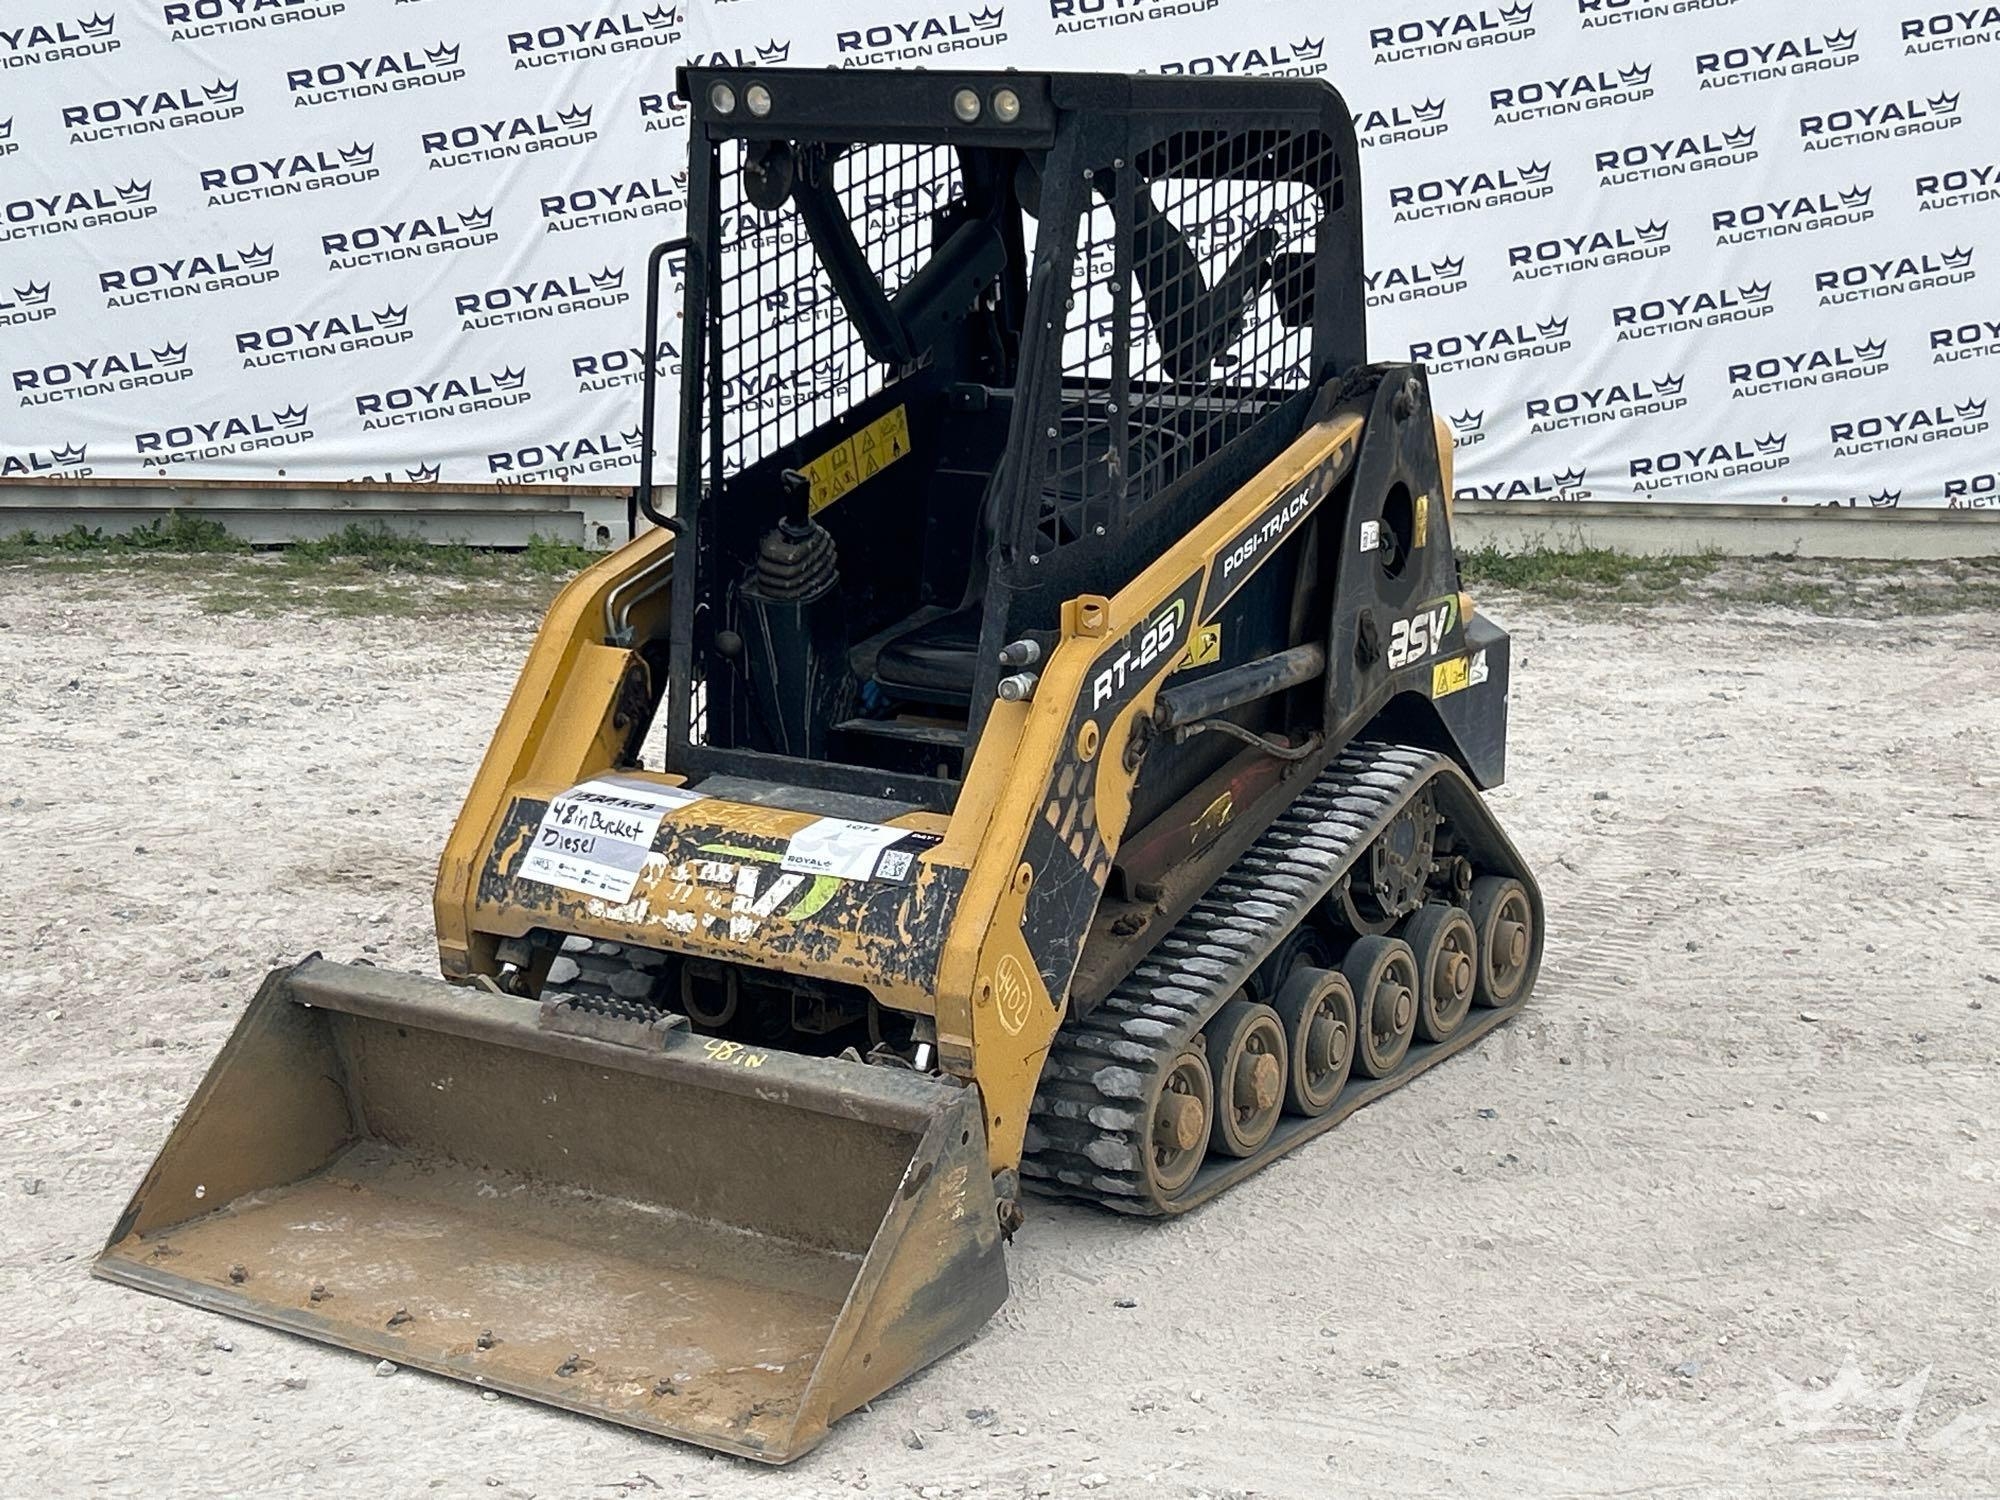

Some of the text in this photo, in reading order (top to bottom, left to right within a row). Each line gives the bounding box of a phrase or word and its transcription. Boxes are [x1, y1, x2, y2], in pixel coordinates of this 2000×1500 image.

[172, 3, 345, 42] AUCTION GROUP
[508, 14, 644, 54] ROYAL
[837, 15, 970, 52] ROYAL
[1055, 11, 1144, 35] AUCTION
[1149, 0, 1218, 19] GROUP
[1370, 11, 1499, 49] ROYAL
[1582, 5, 1668, 29] AUCTION
[1901, 7, 2000, 40] ROYA
[0, 22, 80, 50] YAL
[45, 40, 121, 61] GROUP
[515, 32, 681, 70] AUCTION GROUP
[843, 33, 1007, 69] AUCTION GROUP
[1375, 28, 1535, 65] AUCTION GROUP
[1904, 32, 1990, 56] AUCTION
[287, 52, 426, 91] ROYAL
[1696, 37, 1823, 74] ROYAL
[1700, 54, 1859, 90] AUCTION GROUP
[295, 69, 465, 107] AUCTION GROUP
[1490, 72, 1618, 109] ROYAL
[62, 89, 204, 128] ROYAL
[70, 106, 244, 144] AUCTION GROUP
[1494, 89, 1653, 125] AUCTION GROUP
[1800, 100, 1926, 137] ROYAL
[422, 115, 558, 153] ROYAL
[429, 131, 597, 170] AUCTION GROUP
[1380, 124, 1448, 144] GROUP
[1804, 117, 1961, 152] AUCTION GROUP
[200, 152, 340, 191] ROYAL
[1595, 135, 1722, 172] ROYAL
[1600, 151, 1758, 187] AUCTION GROUP
[208, 169, 379, 207] AUCTION GROUP
[540, 179, 673, 217] ROYAL
[1390, 170, 1517, 207] ROYAL
[1916, 166, 2000, 196] ROY
[0, 189, 117, 225] OYAL
[547, 199, 687, 233] AUCTION GRO
[1394, 186, 1553, 223] AUCTION GROUP
[1712, 194, 1838, 231] ROYAL
[0, 206, 157, 242] UCTION GROUP
[321, 216, 459, 255] ROYAL
[1716, 210, 1874, 246] AUCTION GROUP
[329, 232, 498, 271] AUCTION GROUP
[1509, 229, 1635, 266] ROYAL
[1513, 245, 1670, 282] AUCTION GROUP
[99, 254, 239, 293] ROYAL
[107, 270, 279, 308] AUCTION GROUP
[1363, 265, 1431, 291] YAL
[1399, 281, 1467, 301] GROUP
[1815, 255, 1940, 291] ROYAL
[1819, 271, 1975, 307] AUCTION GROUP
[455, 277, 590, 315] ROYAL
[462, 293, 629, 331] AUCTION GROUP
[1613, 290, 1738, 327] ROYAL
[0, 308, 56, 327] ROUP
[236, 314, 374, 353] ROYAL
[1617, 305, 1773, 342] AUCTION GROUP
[1930, 322, 2000, 349] ROY
[243, 331, 413, 369] AUCTION GROUP
[572, 341, 680, 377] ROYA
[1409, 325, 1536, 363] ROYAL
[1427, 341, 1571, 375] UCTION GROUP
[1933, 343, 2000, 364] AUCTIO
[13, 352, 153, 391] ROYAL
[1729, 348, 1854, 384] ROYAL
[1732, 363, 1888, 399] AUCTION GROUP
[20, 369, 193, 407] AUCTION GROUP
[356, 376, 492, 415] ROYAL
[1526, 383, 1652, 419] ROYAL
[363, 392, 531, 431] AUCTION GROUP
[1531, 398, 1687, 434] AUCTION GROUP
[1831, 407, 1954, 443] ROYAL
[135, 414, 274, 453] ROYAL
[143, 431, 314, 468] AUCTION GROUP
[1834, 422, 1988, 458] AUCTION GROUP
[488, 435, 622, 473] ROYAL
[1630, 442, 1754, 477] ROYAL
[1633, 457, 1789, 492] AUCTION GROUP
[1223, 488, 1310, 578] POSI-TRACK
[1093, 612, 1175, 711] RT-25
[542, 828, 596, 853] Diesel
[589, 811, 644, 841] Bucket
